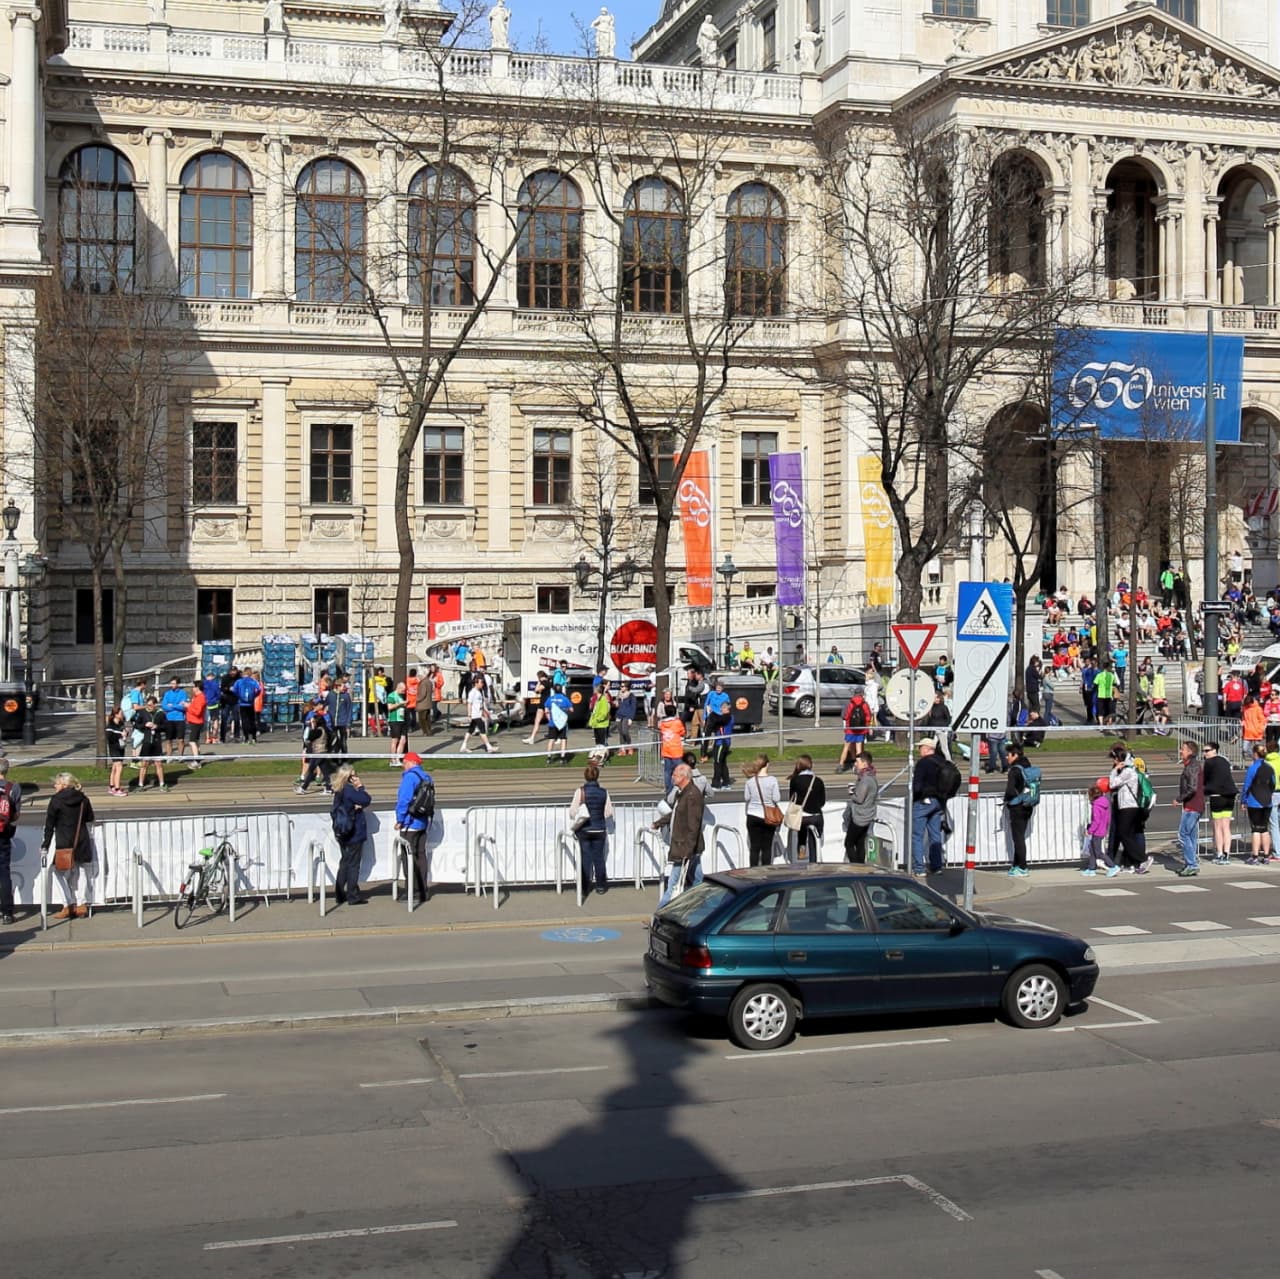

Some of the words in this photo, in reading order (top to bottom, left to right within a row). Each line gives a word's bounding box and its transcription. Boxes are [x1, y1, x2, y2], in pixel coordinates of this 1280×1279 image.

[1069, 361, 1154, 410] 650
[1153, 382, 1227, 400] universiät
[1154, 397, 1190, 411] wien
[532, 624, 608, 632] www.buchbinder.cot
[531, 643, 598, 654] Rent-a-Car
[611, 644, 657, 654] BUCHBIND
[960, 713, 999, 730] Zone
